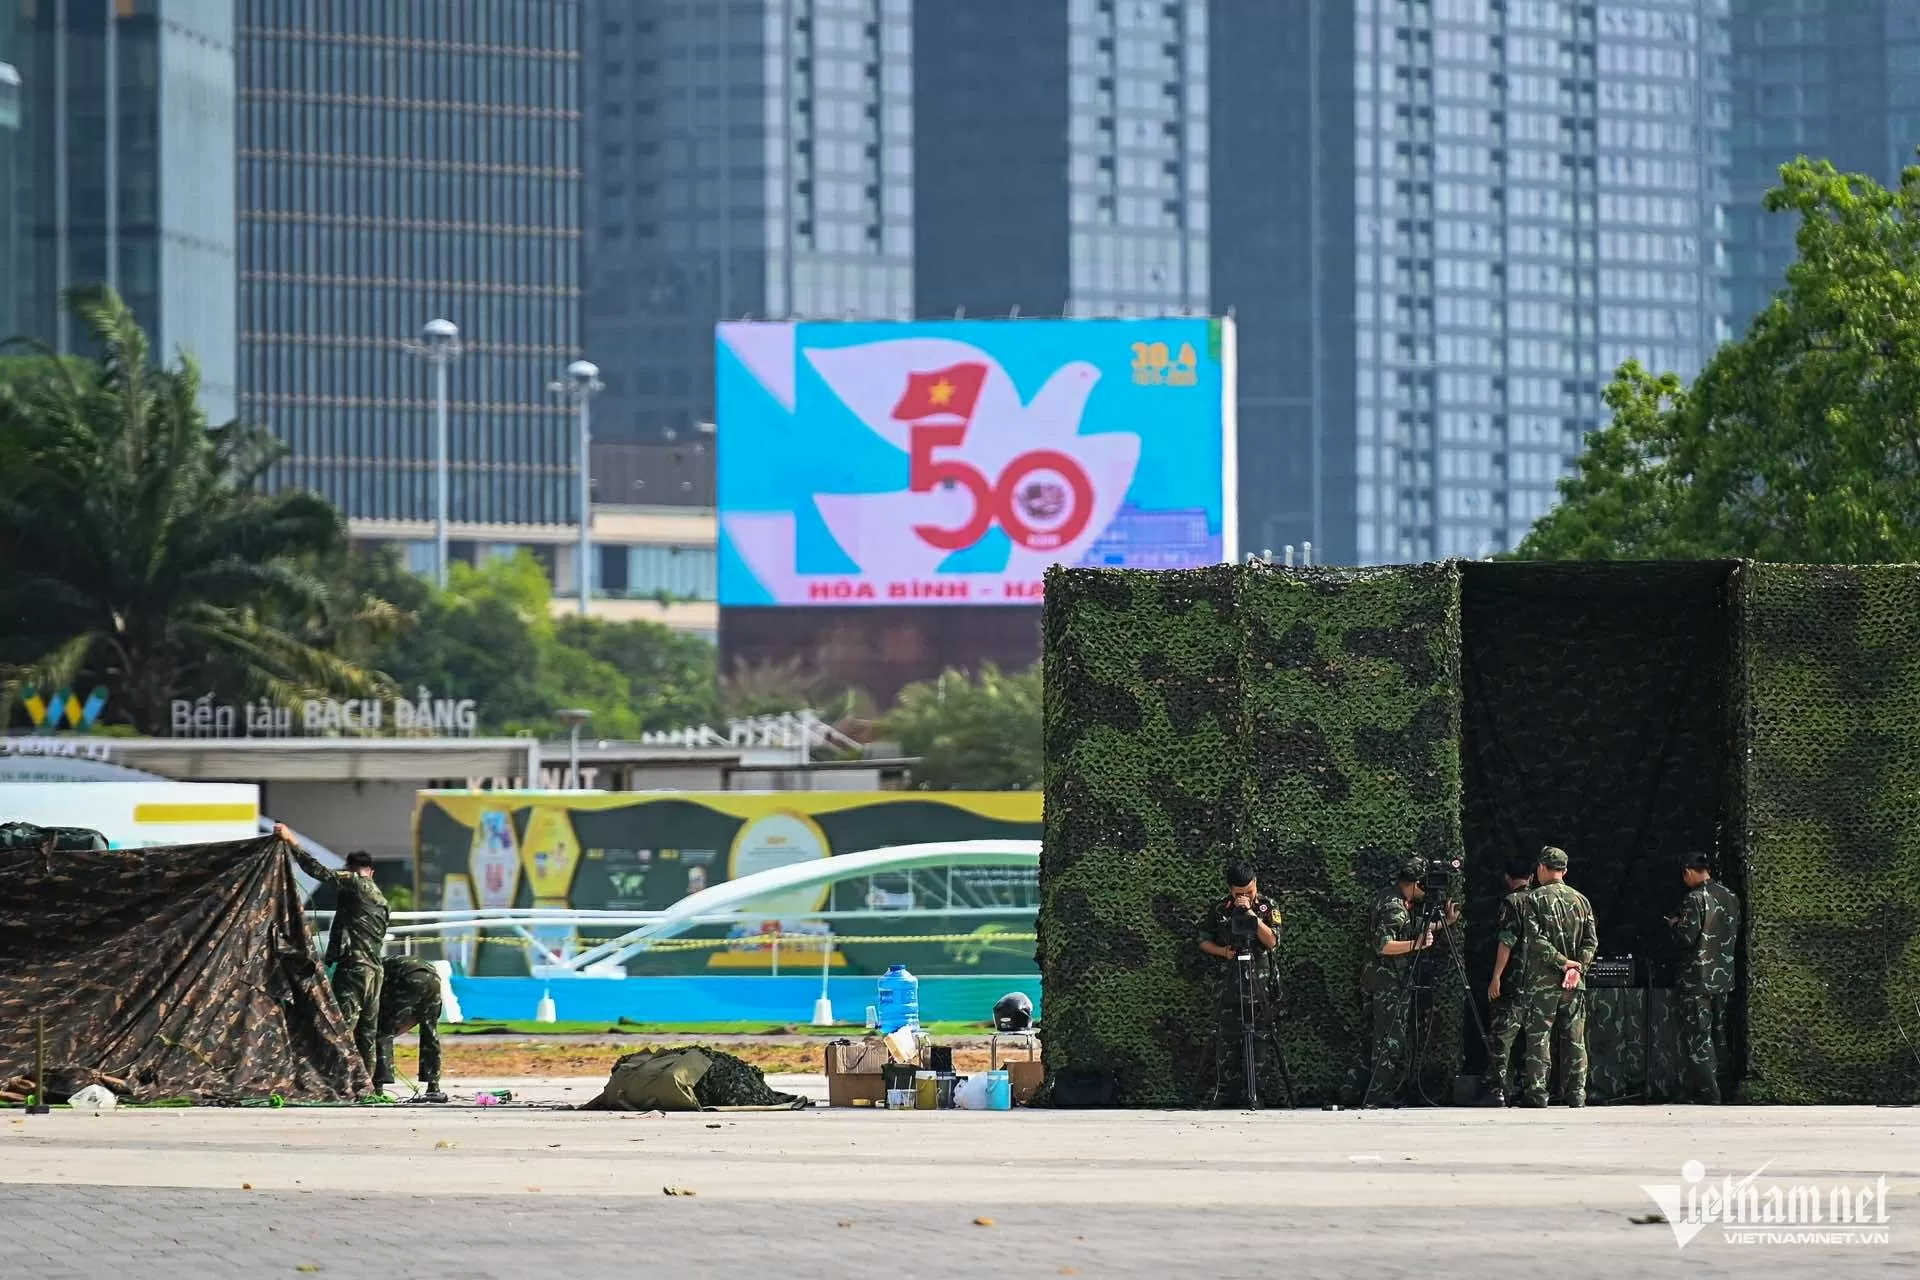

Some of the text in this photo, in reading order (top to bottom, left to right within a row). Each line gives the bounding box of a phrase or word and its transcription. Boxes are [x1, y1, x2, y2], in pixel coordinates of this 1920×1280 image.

[910, 424, 1094, 551] 50
[889, 578, 969, 599] BÌNH
[171, 691, 234, 728] Bến
[246, 697, 291, 728] tàu
